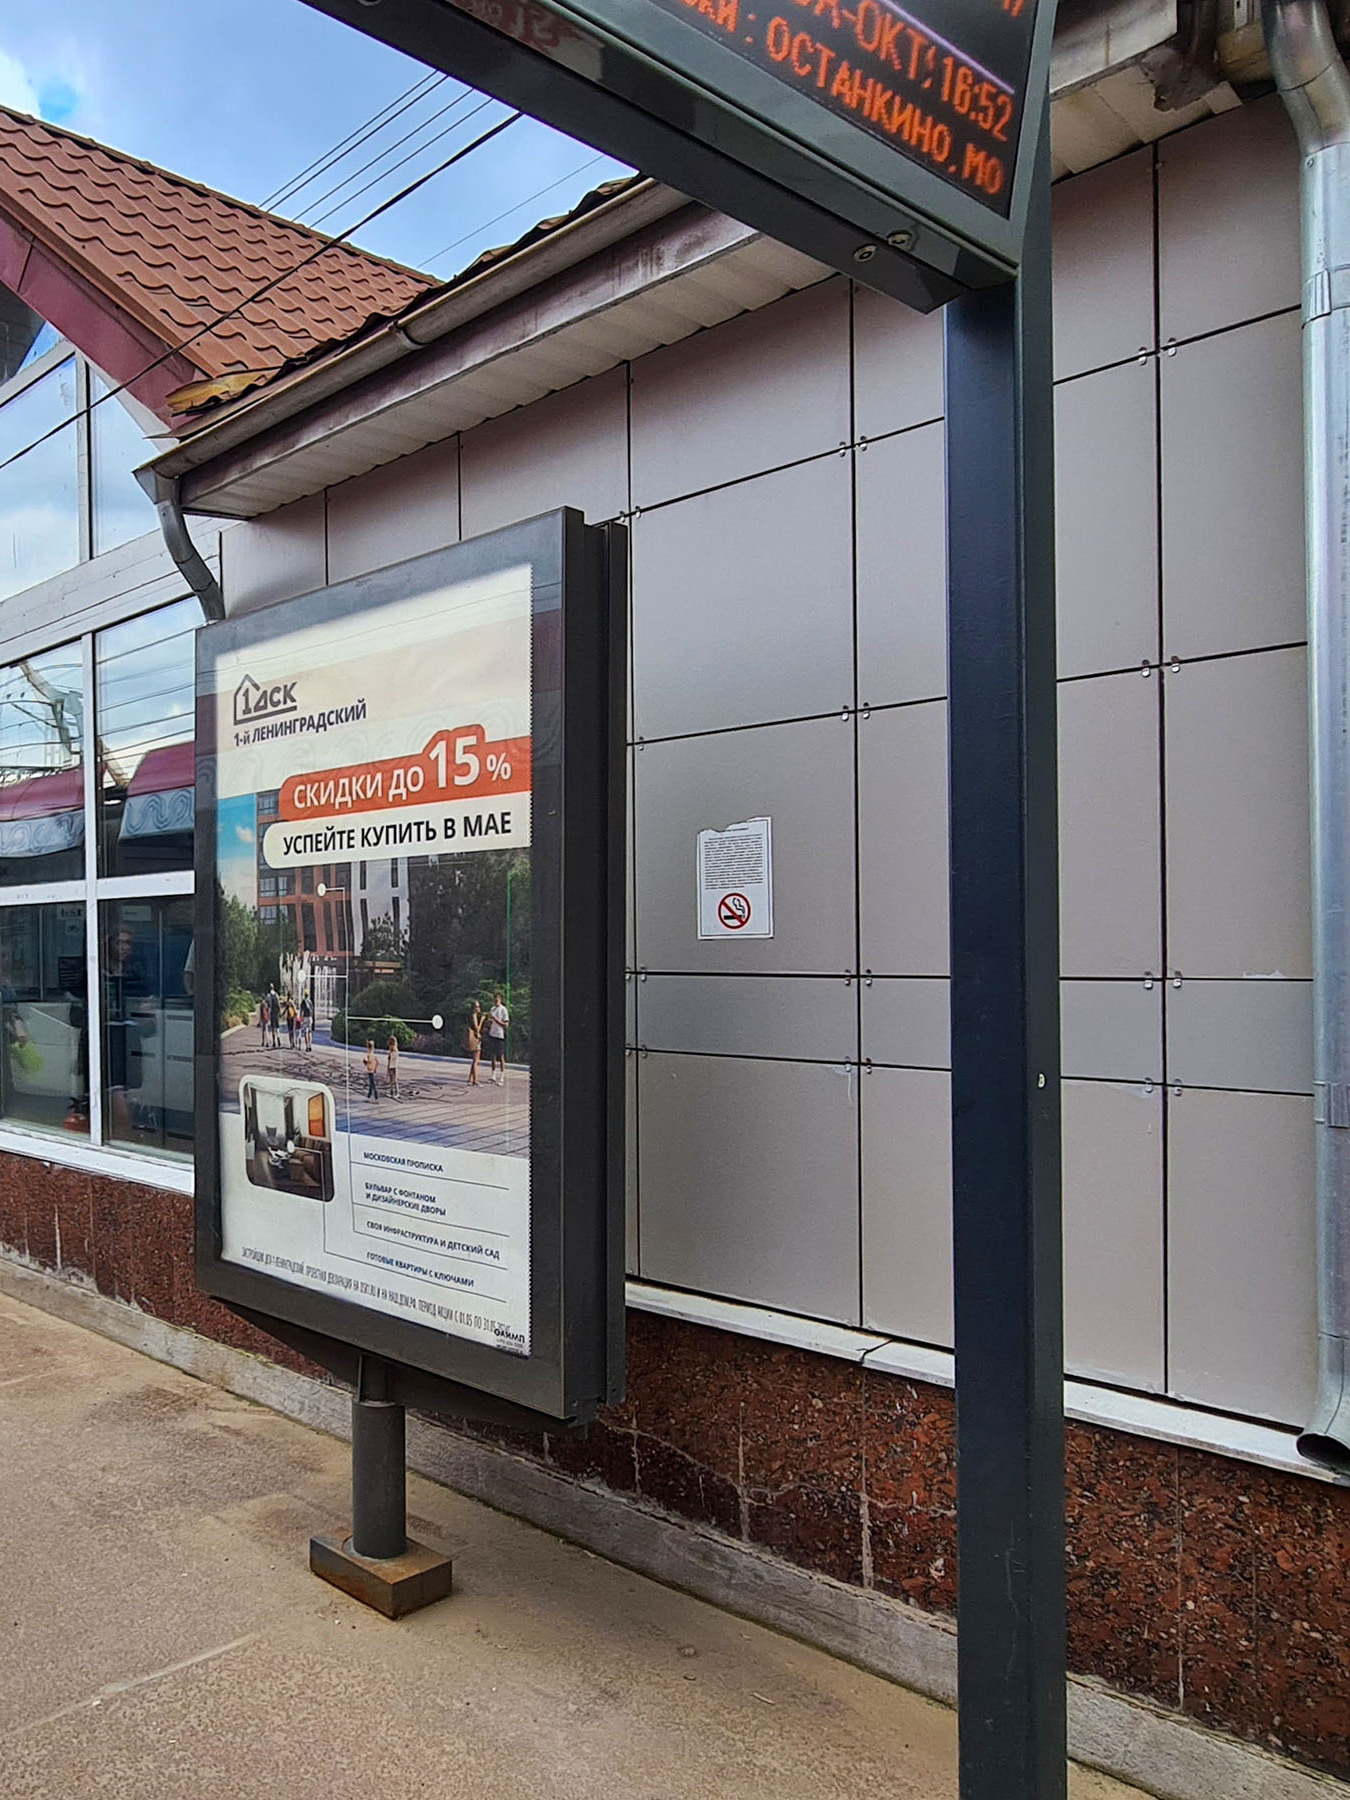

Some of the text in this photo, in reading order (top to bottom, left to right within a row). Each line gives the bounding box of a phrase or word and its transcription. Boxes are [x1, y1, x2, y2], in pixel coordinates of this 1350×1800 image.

[252, 698, 367, 744] ЛЕНИНГРАДСКИЙ
[293, 771, 382, 810] СКИДКИ
[428, 735, 481, 789] 15
[283, 811, 512, 856] УСПЕЙТЕ КУПИТЬ В МАЕ
[363, 1152, 443, 1172] МОСКОВСКАЯ ПРОПИСКА
[365, 1182, 392, 1194] БУЛЬВАР
[399, 1189, 436, 1203] ФОНТАНОМ
[372, 1194, 420, 1211] ДИЗАЙНЕРСКИЕ
[421, 1205, 446, 1216] ДВОРЫ
[366, 1220, 382, 1231] СВОЯ
[383, 1225, 439, 1246] ИНФРАСТРУКТУРА
[448, 1240, 483, 1256] ДЕТСКИЙ
[484, 1248, 500, 1261] САД
[366, 1251, 394, 1265] ГОТОВЫЕ
[395, 1260, 428, 1276] КВАРТИРЫ
[434, 1272, 474, 1287] КЛЮЧАМИ
